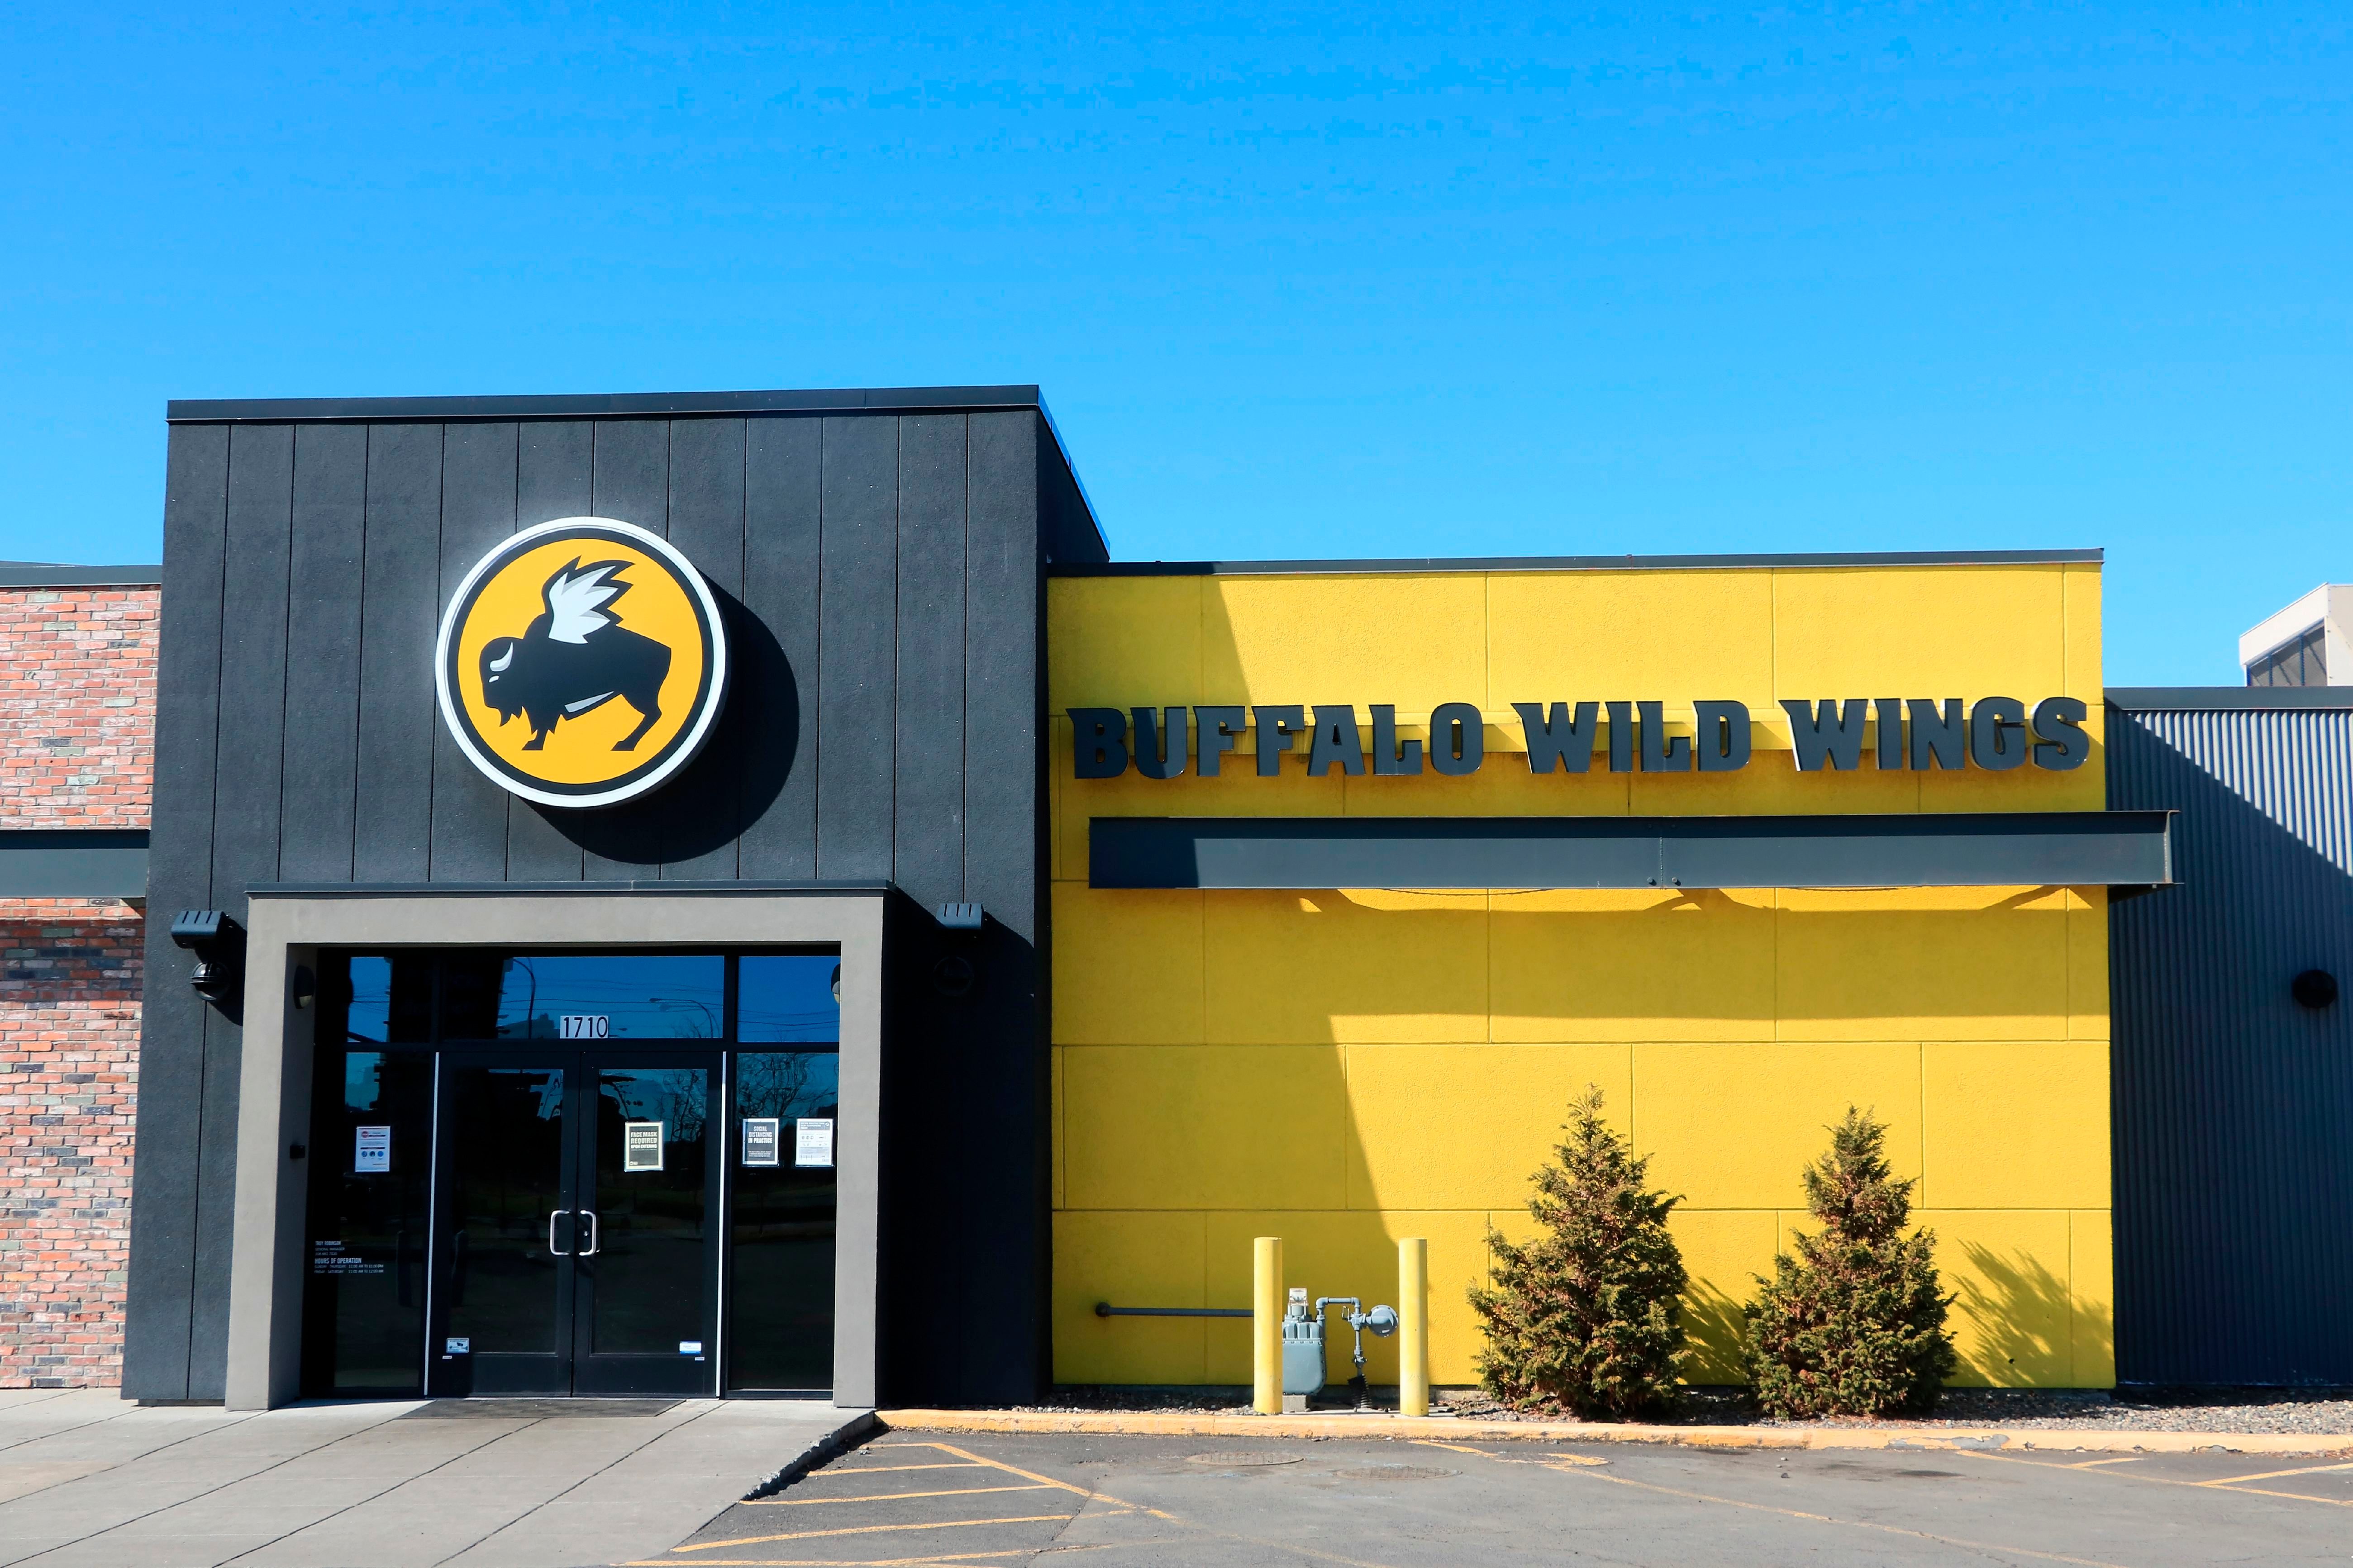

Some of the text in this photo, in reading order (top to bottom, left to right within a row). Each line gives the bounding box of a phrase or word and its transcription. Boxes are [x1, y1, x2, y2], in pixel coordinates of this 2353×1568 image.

[1065, 696, 2090, 779] BUFFALO WILD WINGS
[564, 1016, 608, 1038] 1710
